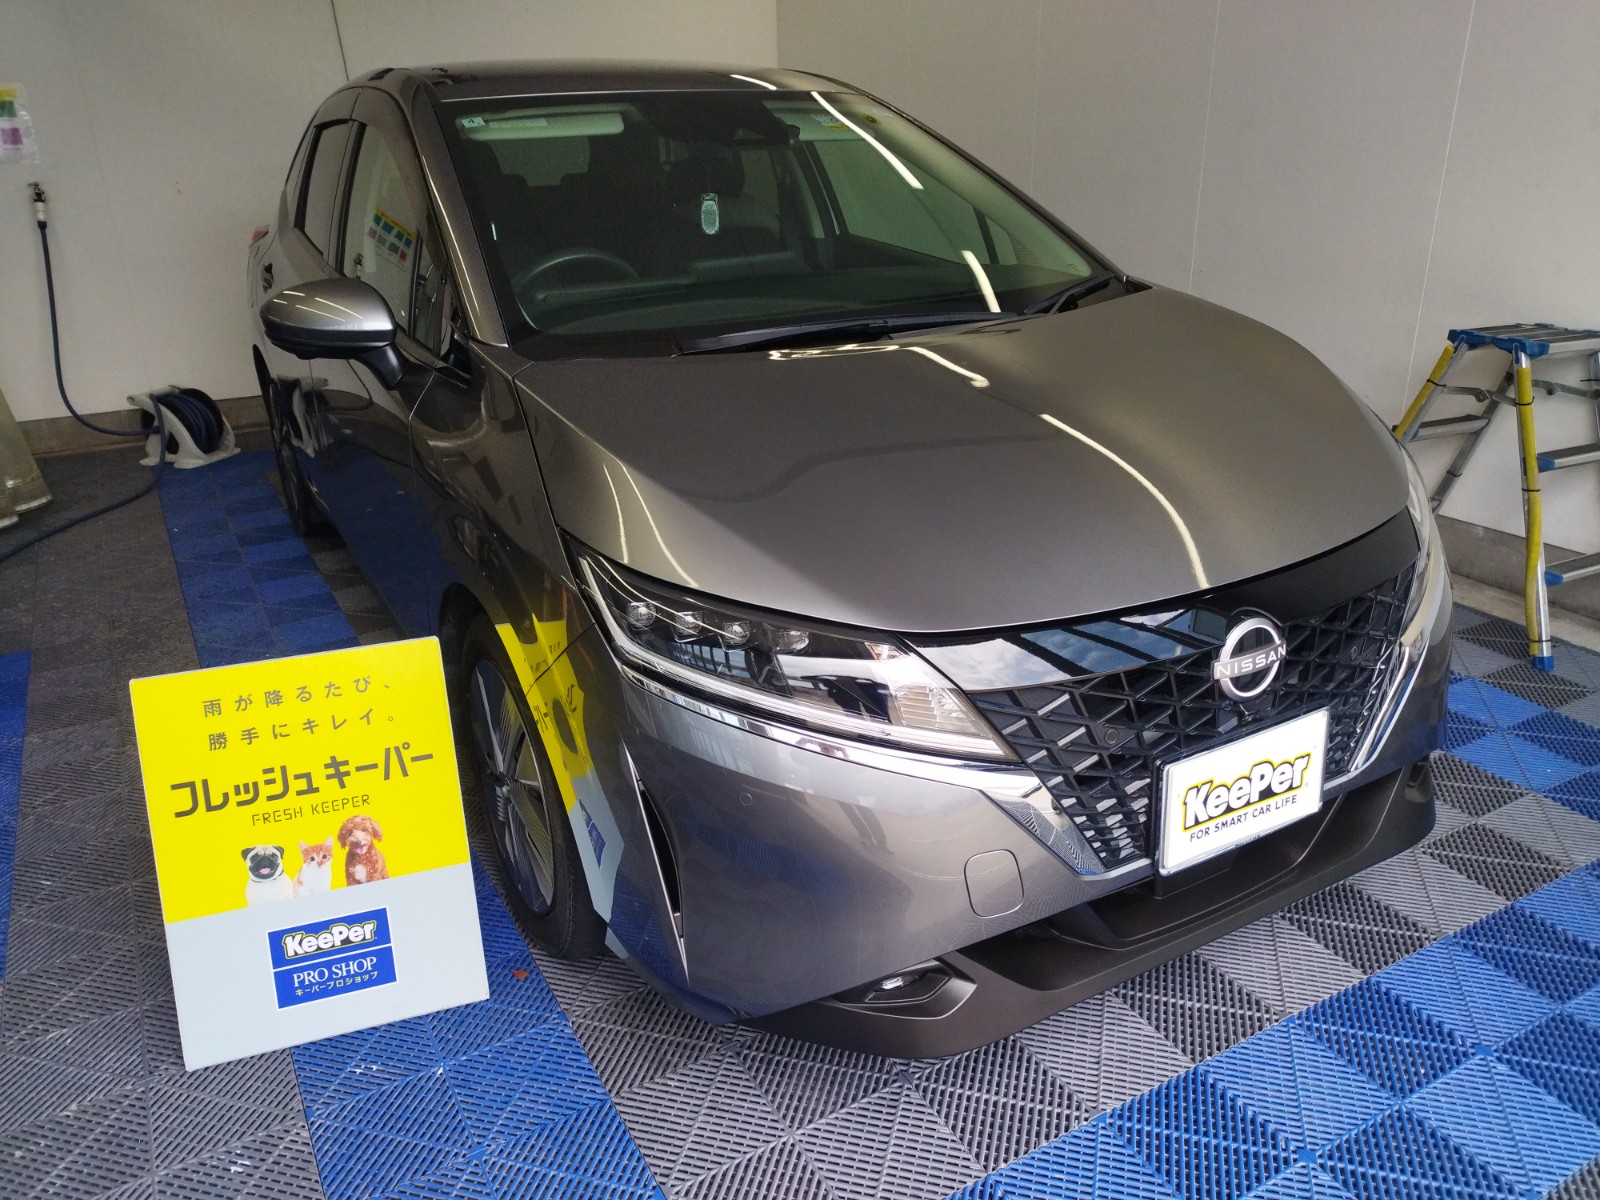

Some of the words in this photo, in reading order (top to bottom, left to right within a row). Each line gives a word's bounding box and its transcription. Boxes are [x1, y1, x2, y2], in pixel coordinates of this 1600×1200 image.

[1217, 643, 1286, 678] NISSAN
[202, 675, 390, 718] 雨が降るたび、
[209, 708, 394, 751] 勝手にキレイ。
[170, 741, 434, 818] フレッシュキーパー
[1183, 753, 1311, 831] KeePer
[251, 806, 303, 826] FRESH
[311, 794, 371, 816] KEEPER
[1190, 826, 1210, 843] FOR
[1214, 812, 1248, 833] SMART
[1252, 804, 1271, 818] CAR
[1275, 794, 1298, 811] LIFE
[282, 920, 377, 960] KeePer
[292, 967, 329, 988] PRO
[331, 956, 377, 979] SHOP
